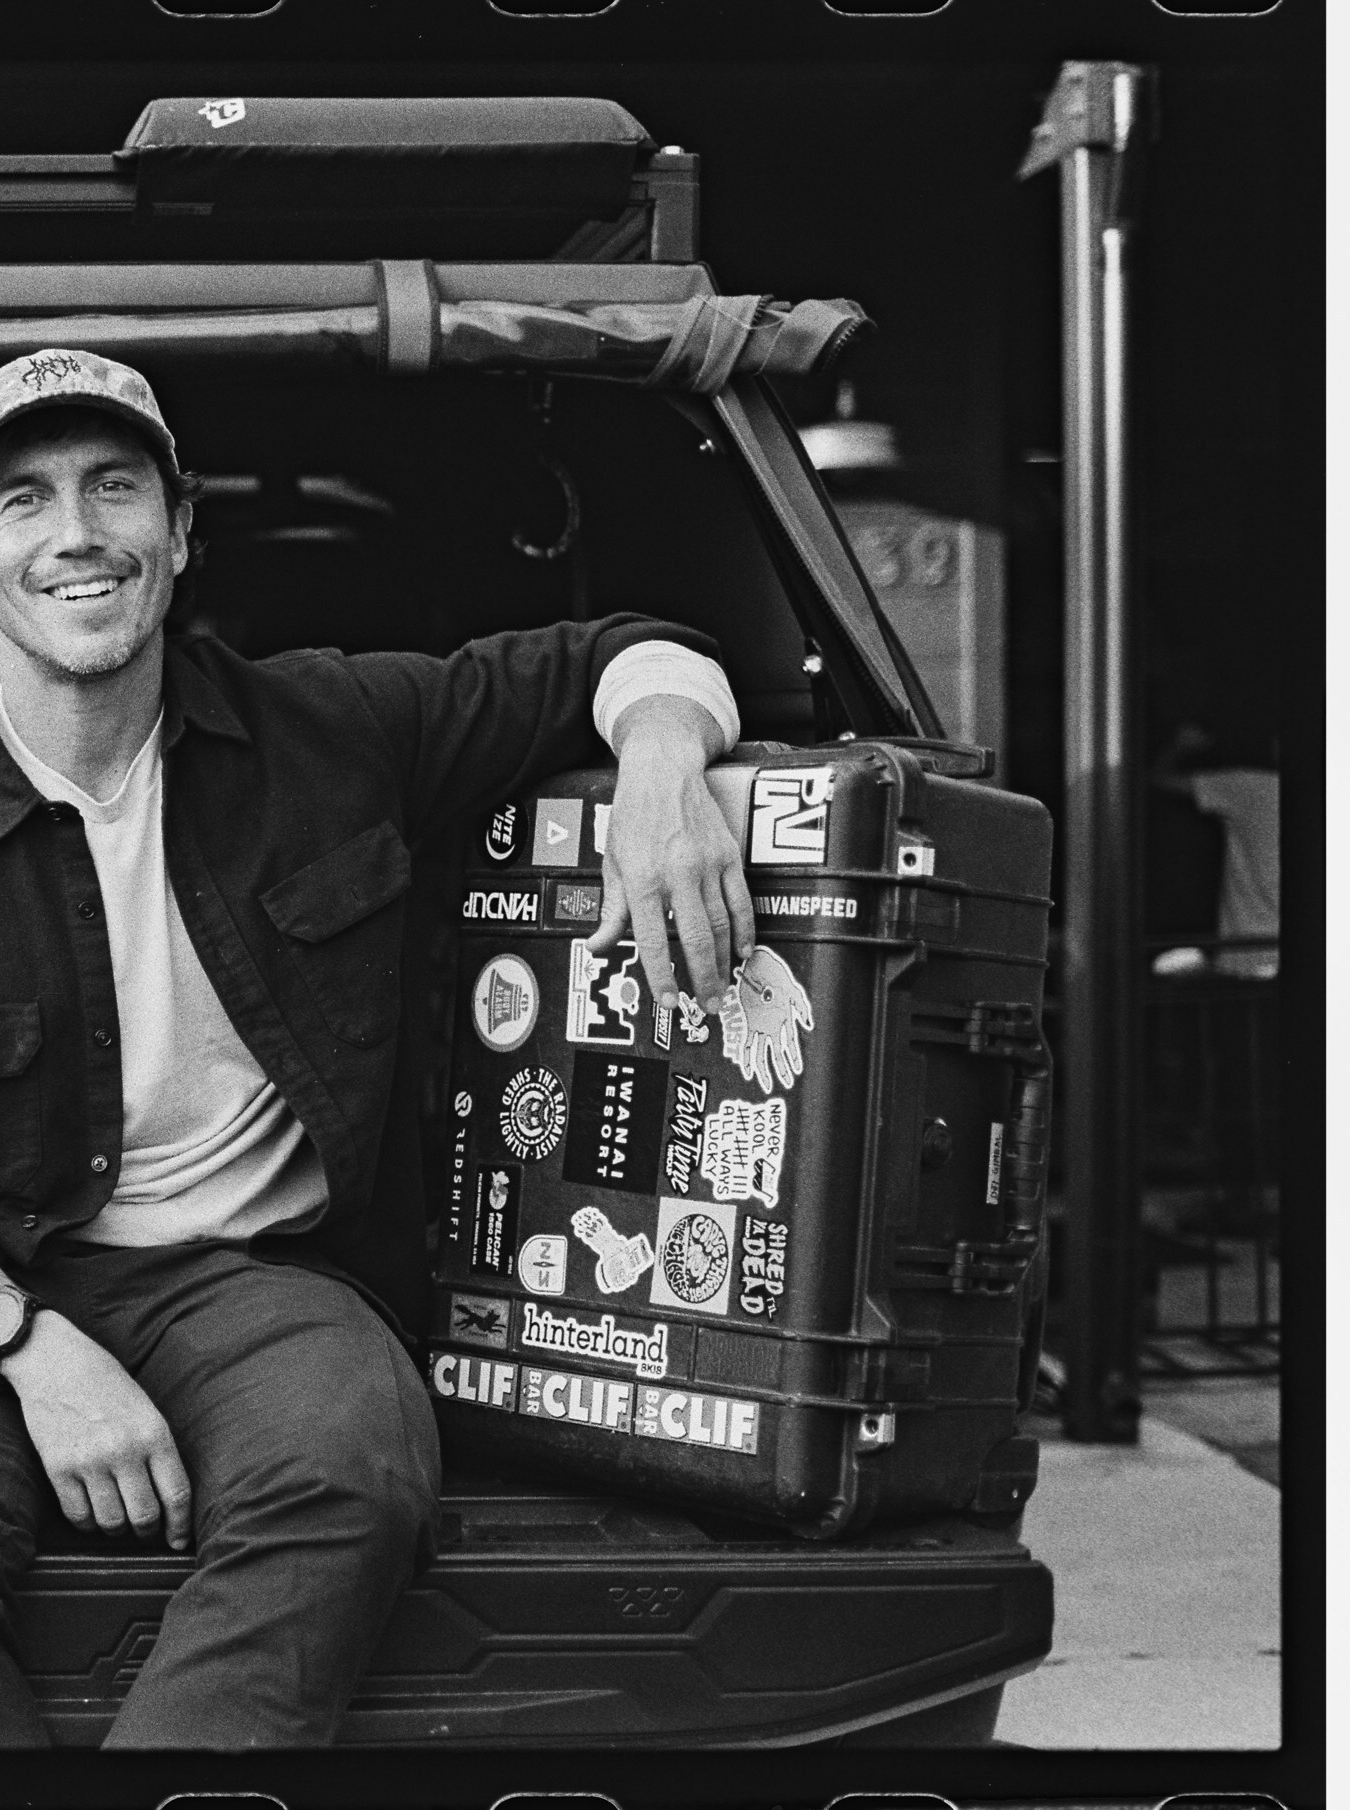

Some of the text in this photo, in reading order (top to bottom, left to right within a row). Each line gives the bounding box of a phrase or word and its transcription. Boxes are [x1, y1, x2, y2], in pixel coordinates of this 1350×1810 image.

[490, 813, 504, 843] IZE
[499, 803, 517, 847] NITE
[463, 891, 538, 921] HANDUP
[770, 895, 858, 918] VANSPEED
[500, 1067, 531, 1160] SHRED LIGHTLY
[535, 1068, 566, 1160] THE RADAVIST
[597, 1064, 617, 1178] RESORT
[611, 1066, 635, 1179] IWANAI
[670, 1074, 706, 1194] Party Time
[752, 1109, 765, 1154] KOOL
[706, 1119, 720, 1176] LUCKY
[717, 1105, 735, 1195] ALL WAYS
[449, 1127, 466, 1241] REDSHIFT
[485, 1236, 493, 1264] CASE
[492, 1212, 503, 1267] PELICAN
[665, 1220, 687, 1293] THE CHAOS
[691, 1215, 726, 1258] CARVE
[765, 1222, 789, 1295] SHRED
[740, 1219, 767, 1314] YA DEAD
[525, 1309, 664, 1363] hinterland
[434, 1354, 514, 1407] CLIF
[641, 1363, 662, 1375] SKIS
[527, 1369, 629, 1428] BAR CLIF
[644, 1390, 755, 1449] BAR CLIF
